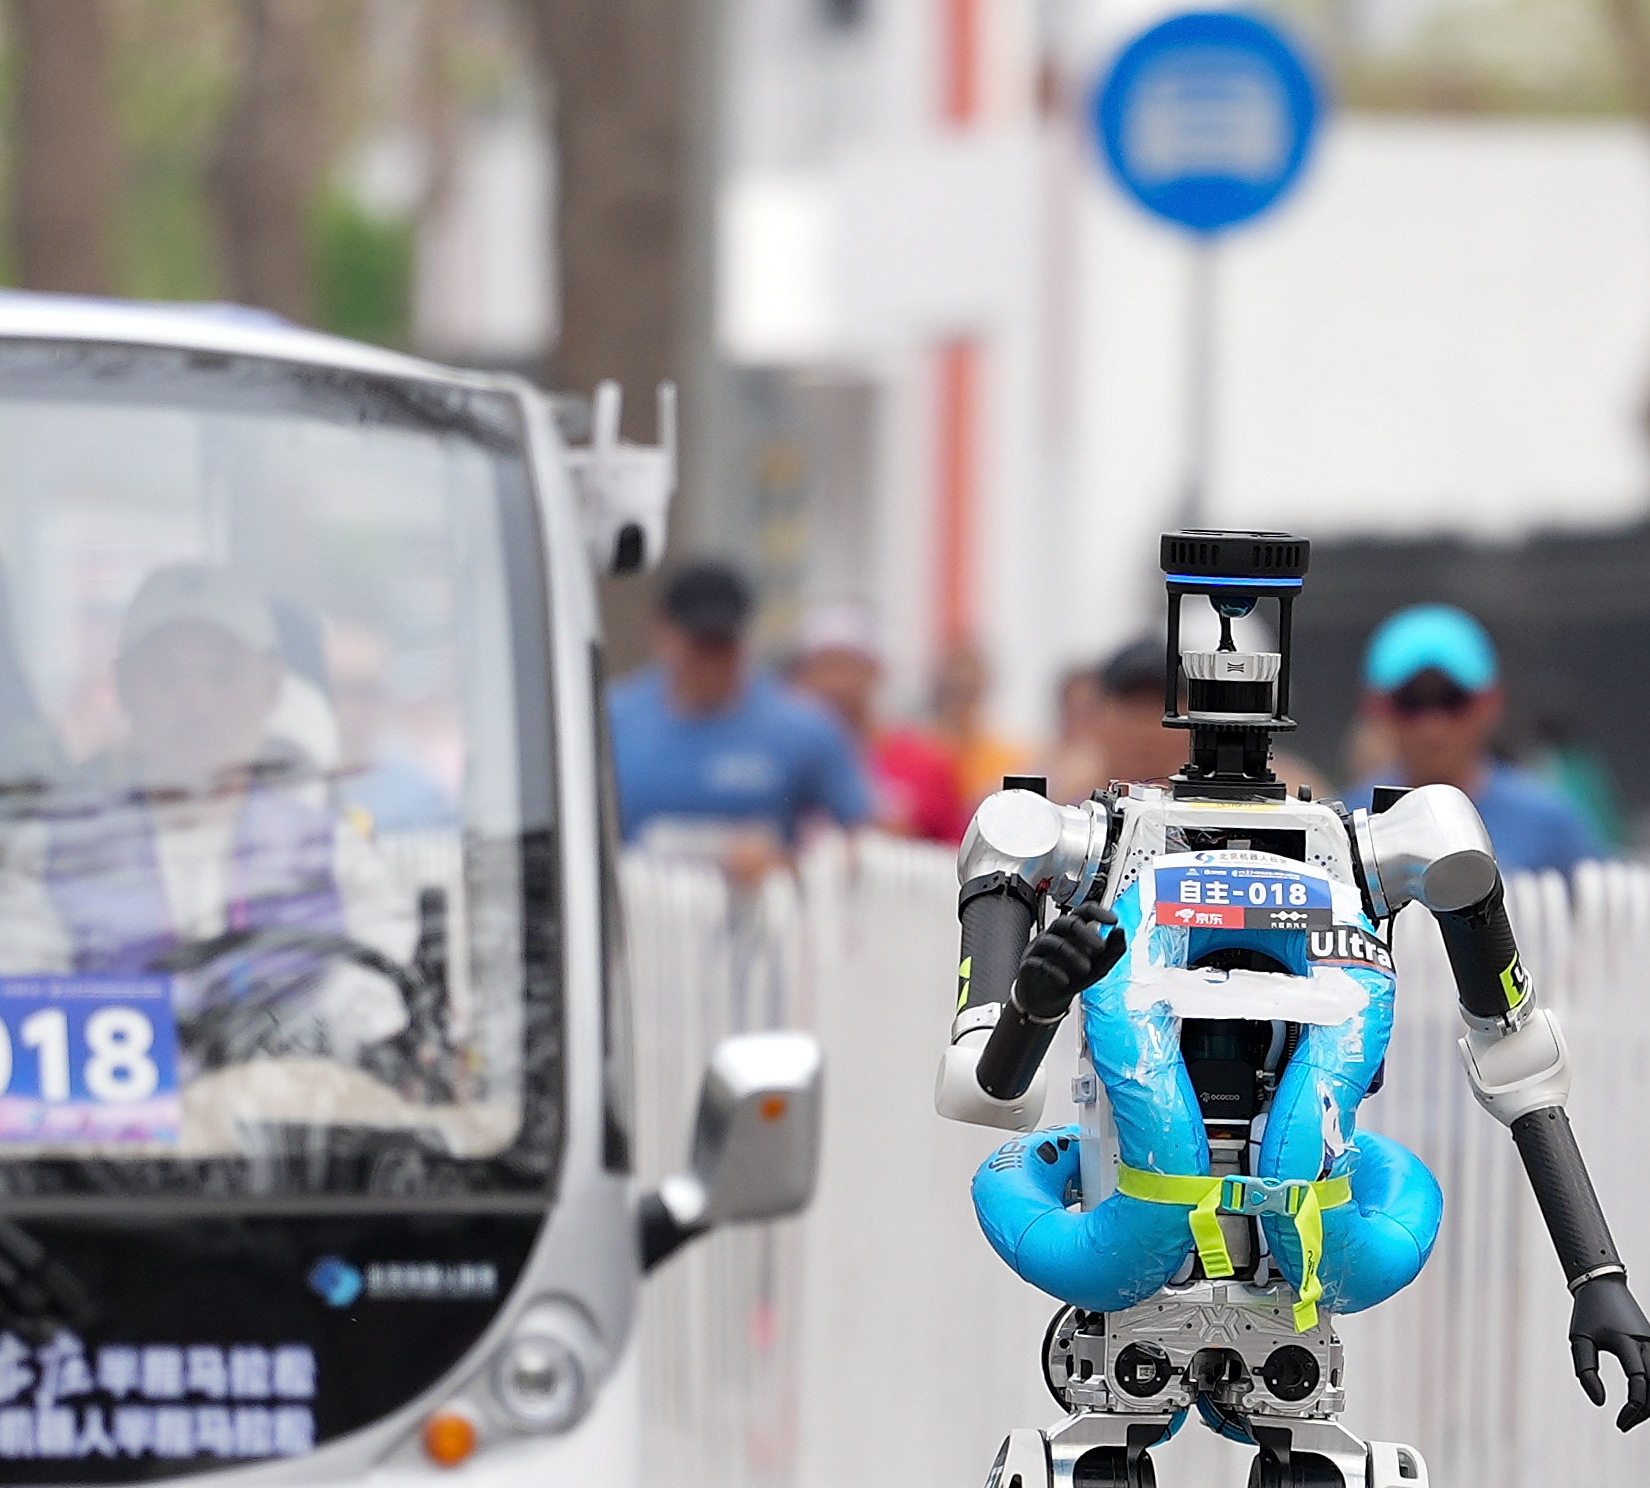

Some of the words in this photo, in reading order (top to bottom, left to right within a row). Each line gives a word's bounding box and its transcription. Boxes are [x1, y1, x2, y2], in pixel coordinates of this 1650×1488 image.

[1179, 879, 1307, 906] 自主-018
[1195, 913, 1223, 925] 京东
[1311, 929, 1393, 970] Ultra
